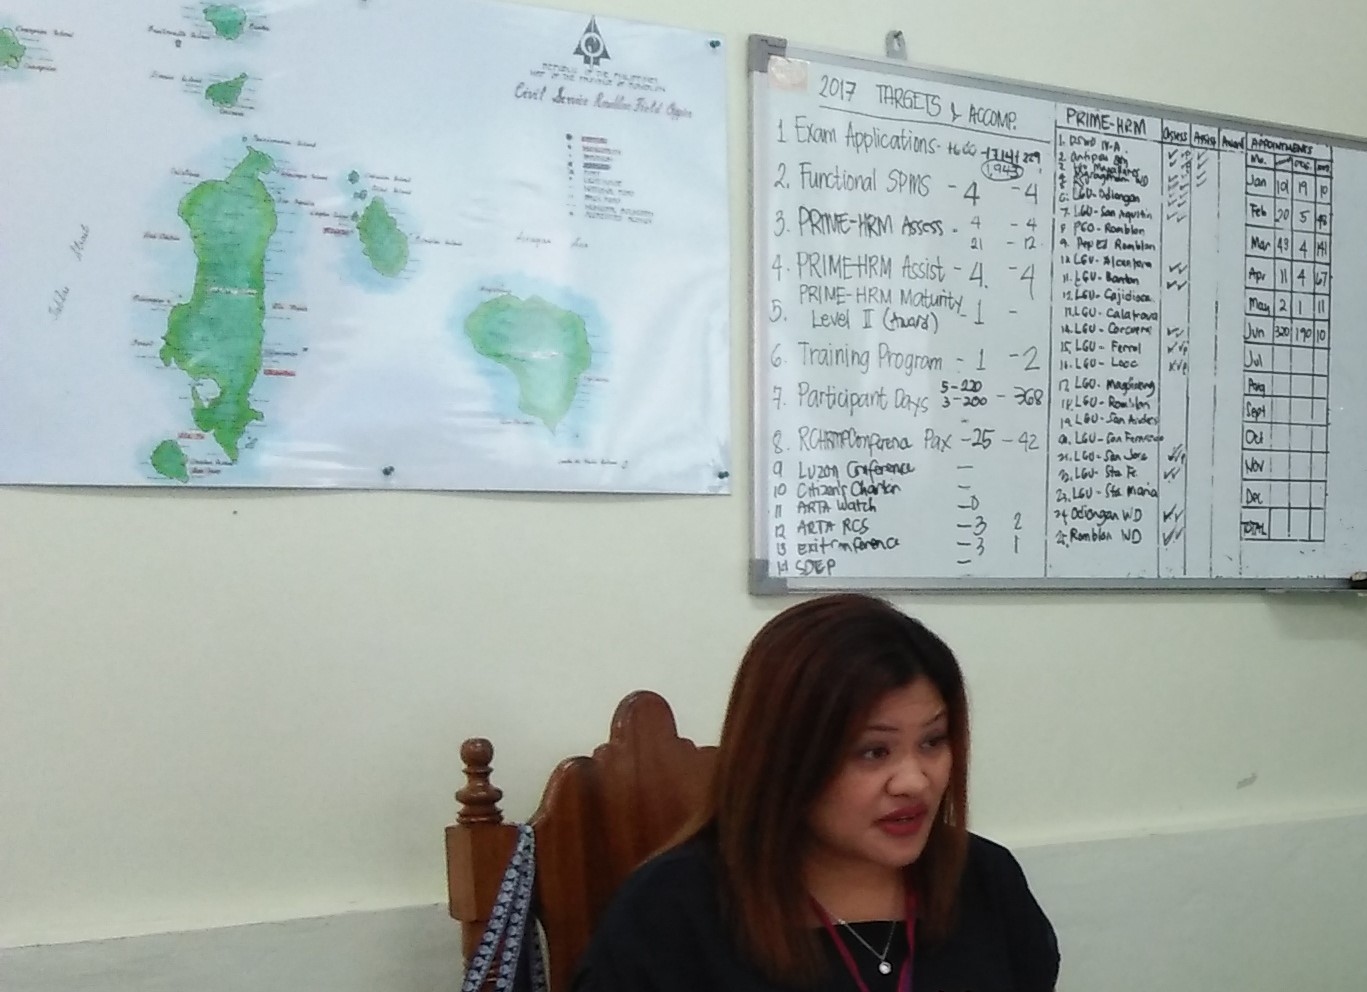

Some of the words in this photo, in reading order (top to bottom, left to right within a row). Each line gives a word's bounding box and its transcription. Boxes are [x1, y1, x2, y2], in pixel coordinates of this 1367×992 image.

[819, 75, 857, 100] 2017
[876, 84, 941, 116] TARGETS
[795, 116, 837, 144] Exam
[799, 162, 877, 192] Functional
[900, 287, 963, 312] Maturity
[811, 308, 851, 329] Level
[1243, 322, 1265, 340] Jun
[798, 341, 870, 374] Training
[878, 342, 942, 376] Program
[1244, 350, 1263, 368] Jul
[798, 382, 887, 416] Participant
[894, 388, 928, 417] Days
[1245, 430, 1264, 444] Oct
[798, 461, 839, 480] Luzon
[1245, 457, 1264, 473] Nov
[797, 500, 834, 516] ARTA
[795, 560, 837, 576] SDEP
